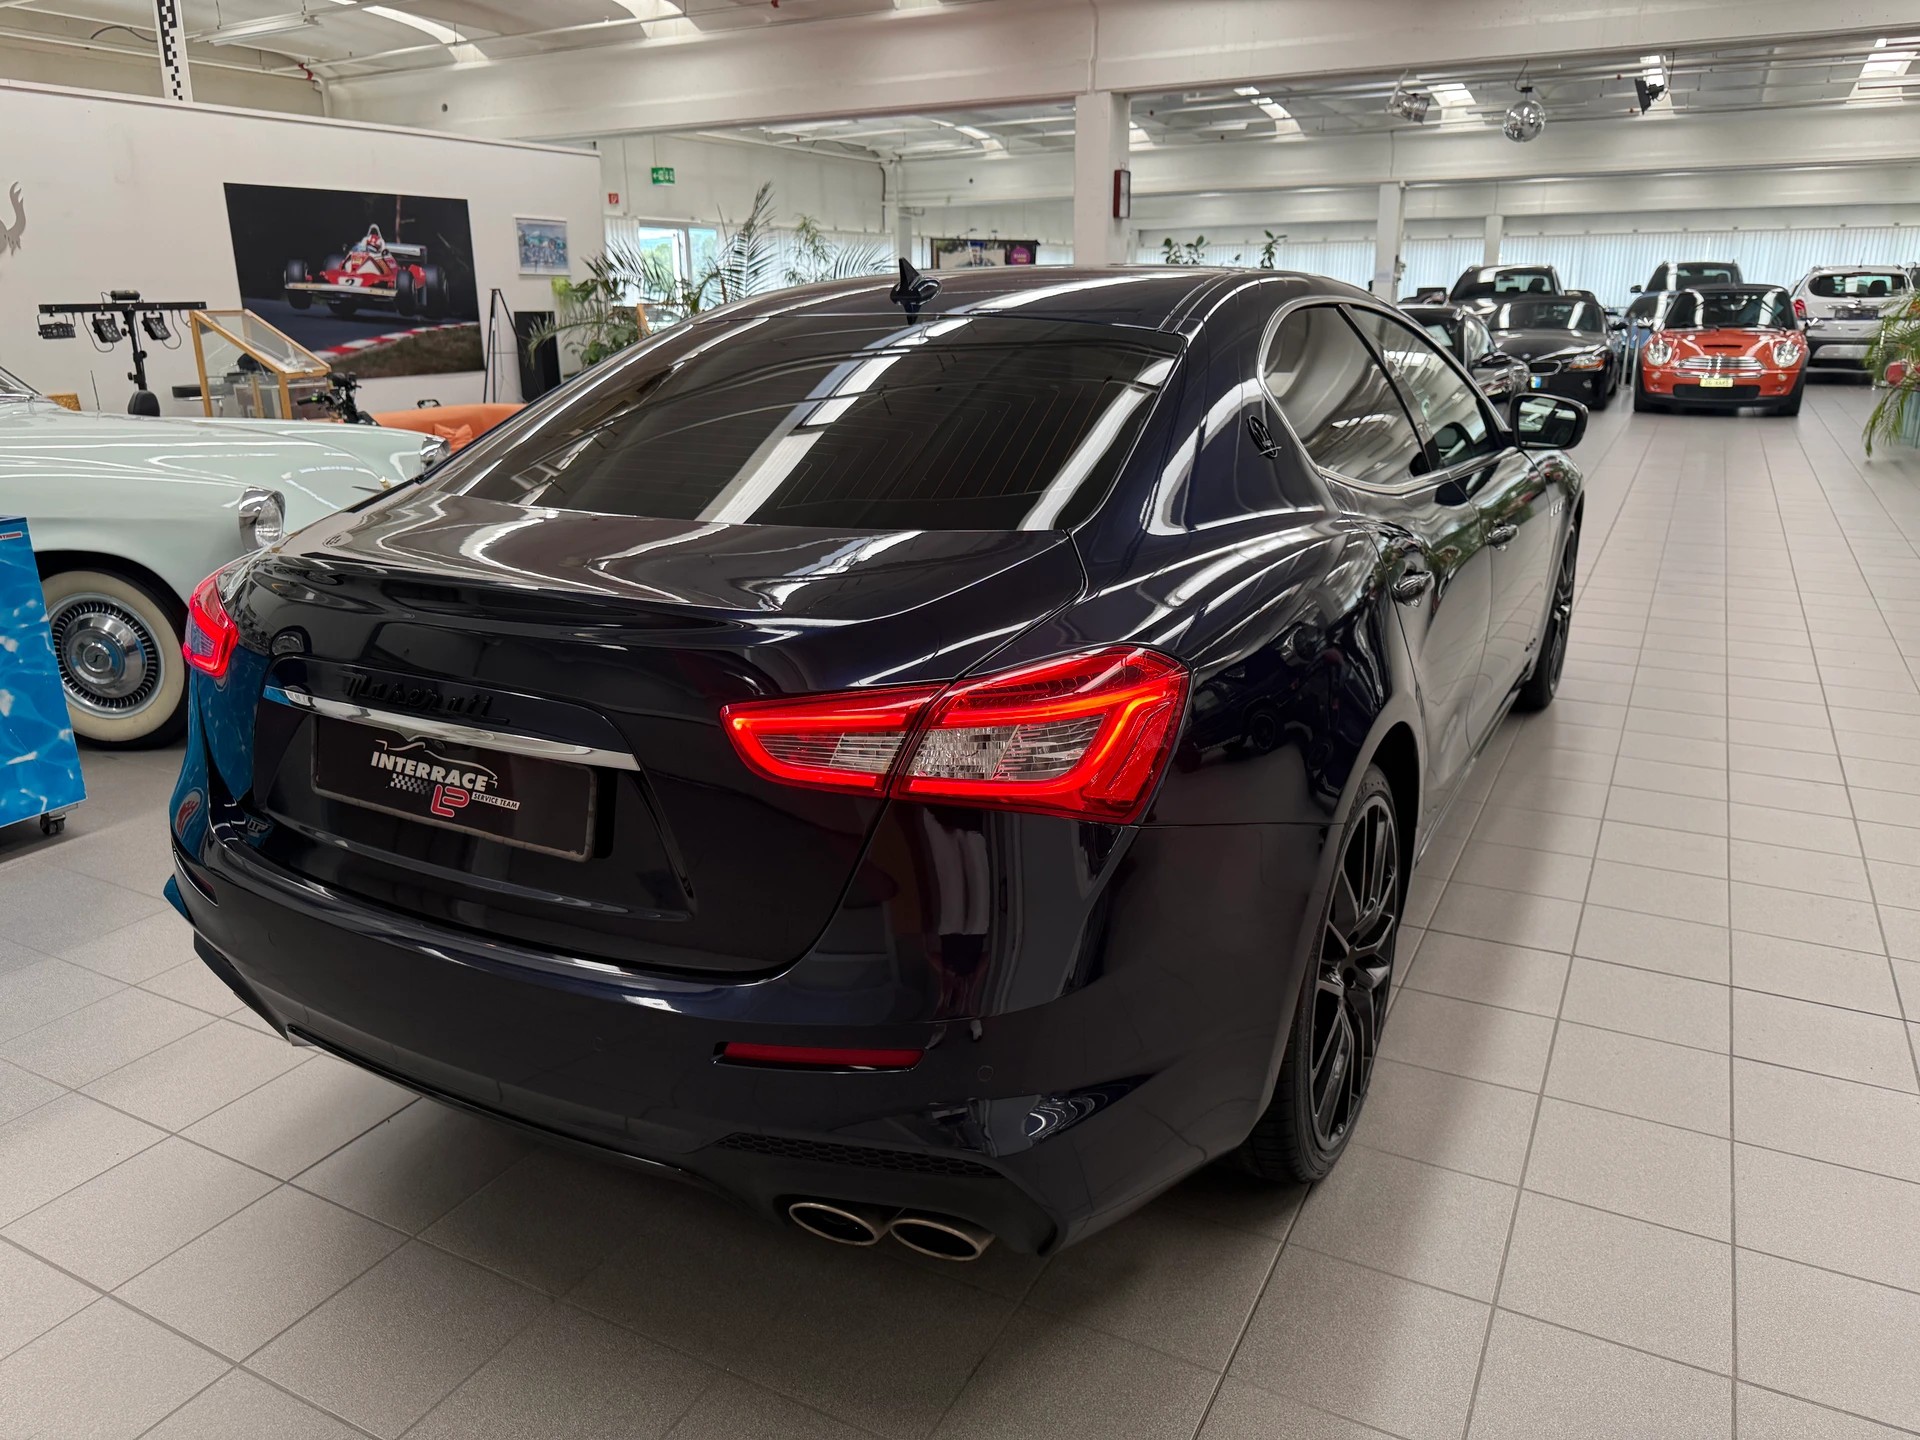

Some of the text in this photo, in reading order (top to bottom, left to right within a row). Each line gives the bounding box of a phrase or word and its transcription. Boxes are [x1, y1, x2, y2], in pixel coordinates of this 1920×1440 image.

[371, 751, 488, 792] INTERRACE
[473, 793, 518, 809] SERVICE TEAM
